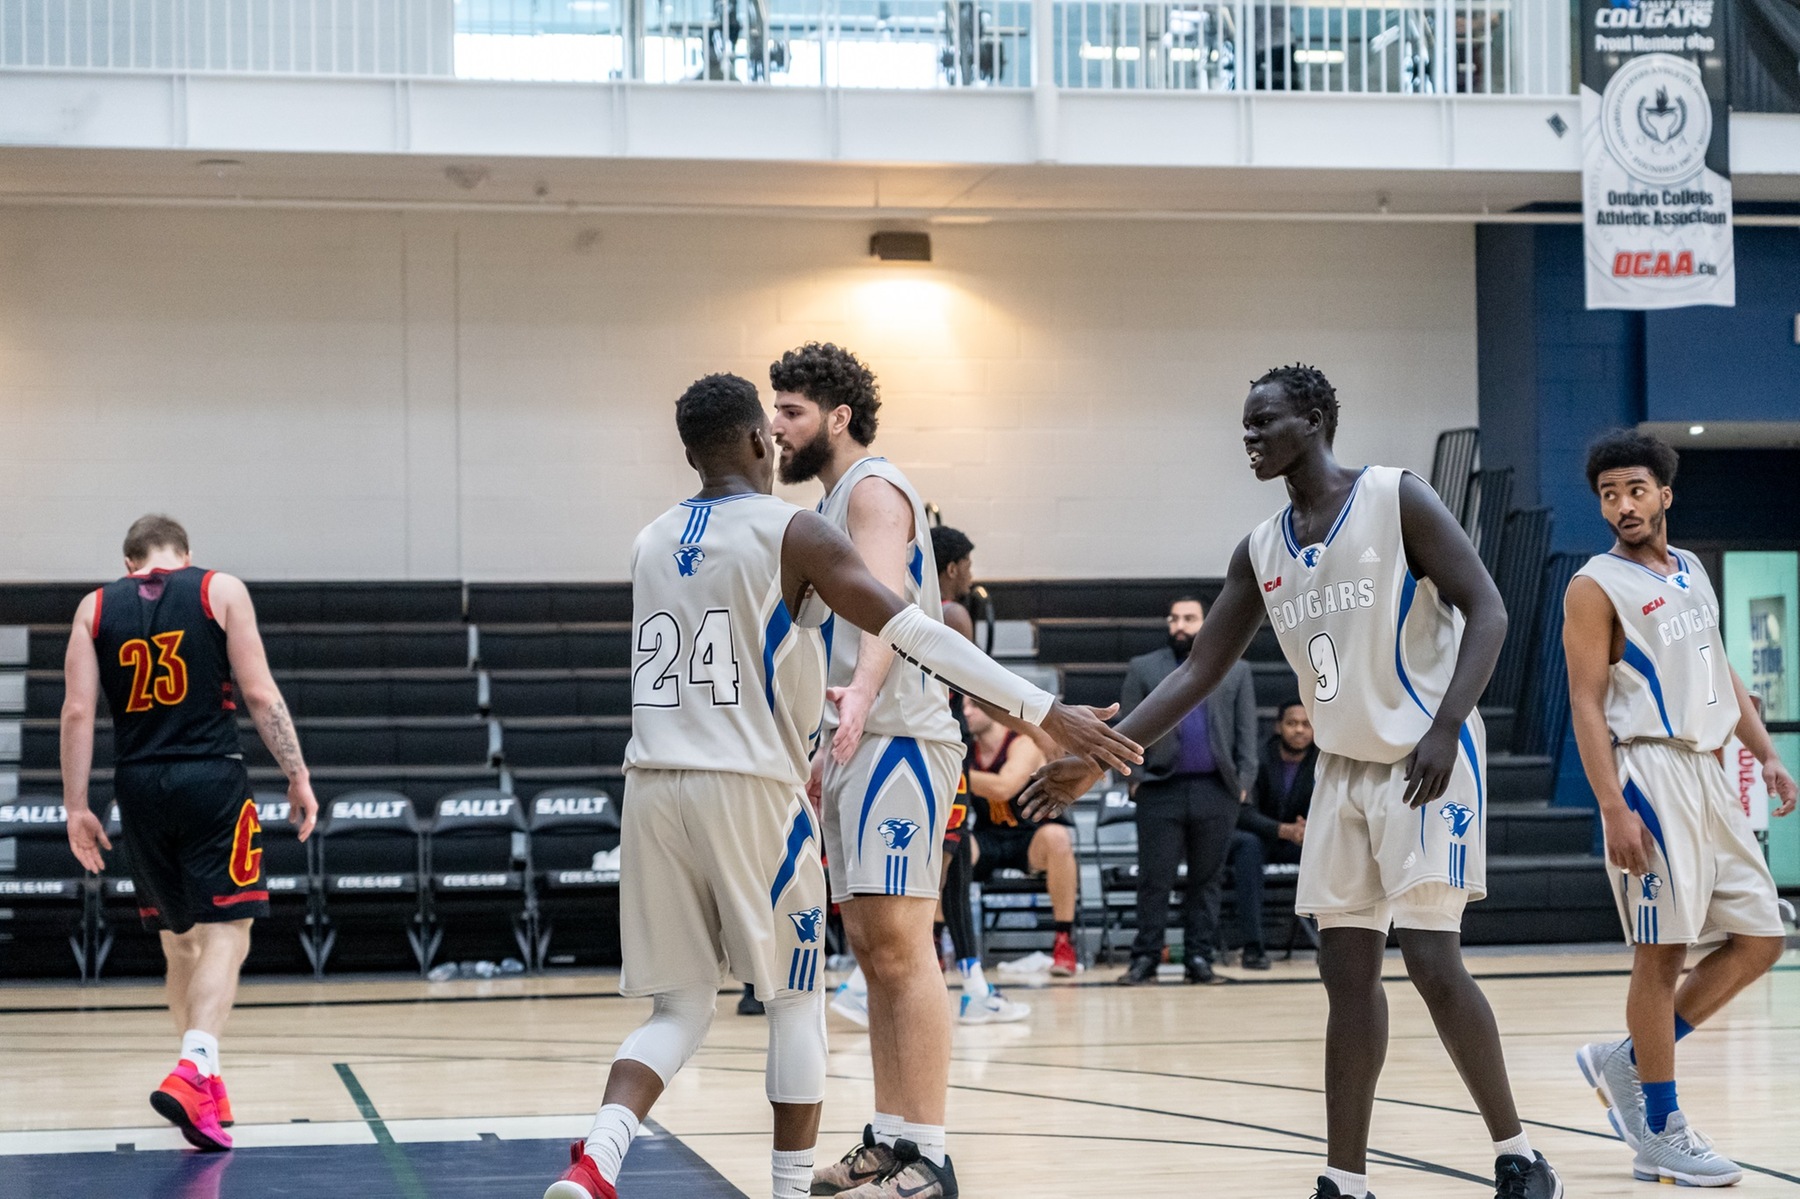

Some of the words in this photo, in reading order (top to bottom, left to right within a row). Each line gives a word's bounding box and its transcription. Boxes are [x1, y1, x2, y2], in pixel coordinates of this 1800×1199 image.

[1595, 8, 1713, 28] COUGARS
[1595, 34, 1631, 51] Proud
[1633, 34, 1685, 51] Member
[1608, 189, 1659, 206] Ontario
[1597, 211, 1651, 226] Athletic
[1653, 209, 1727, 226] Associaon
[632, 608, 741, 709] 24
[1307, 632, 1340, 704] 9
[119, 630, 188, 713] 23
[332, 800, 407, 819] SAULT
[439, 799, 515, 817] SAULT
[535, 797, 608, 815] SAULT
[229, 798, 263, 887] C
